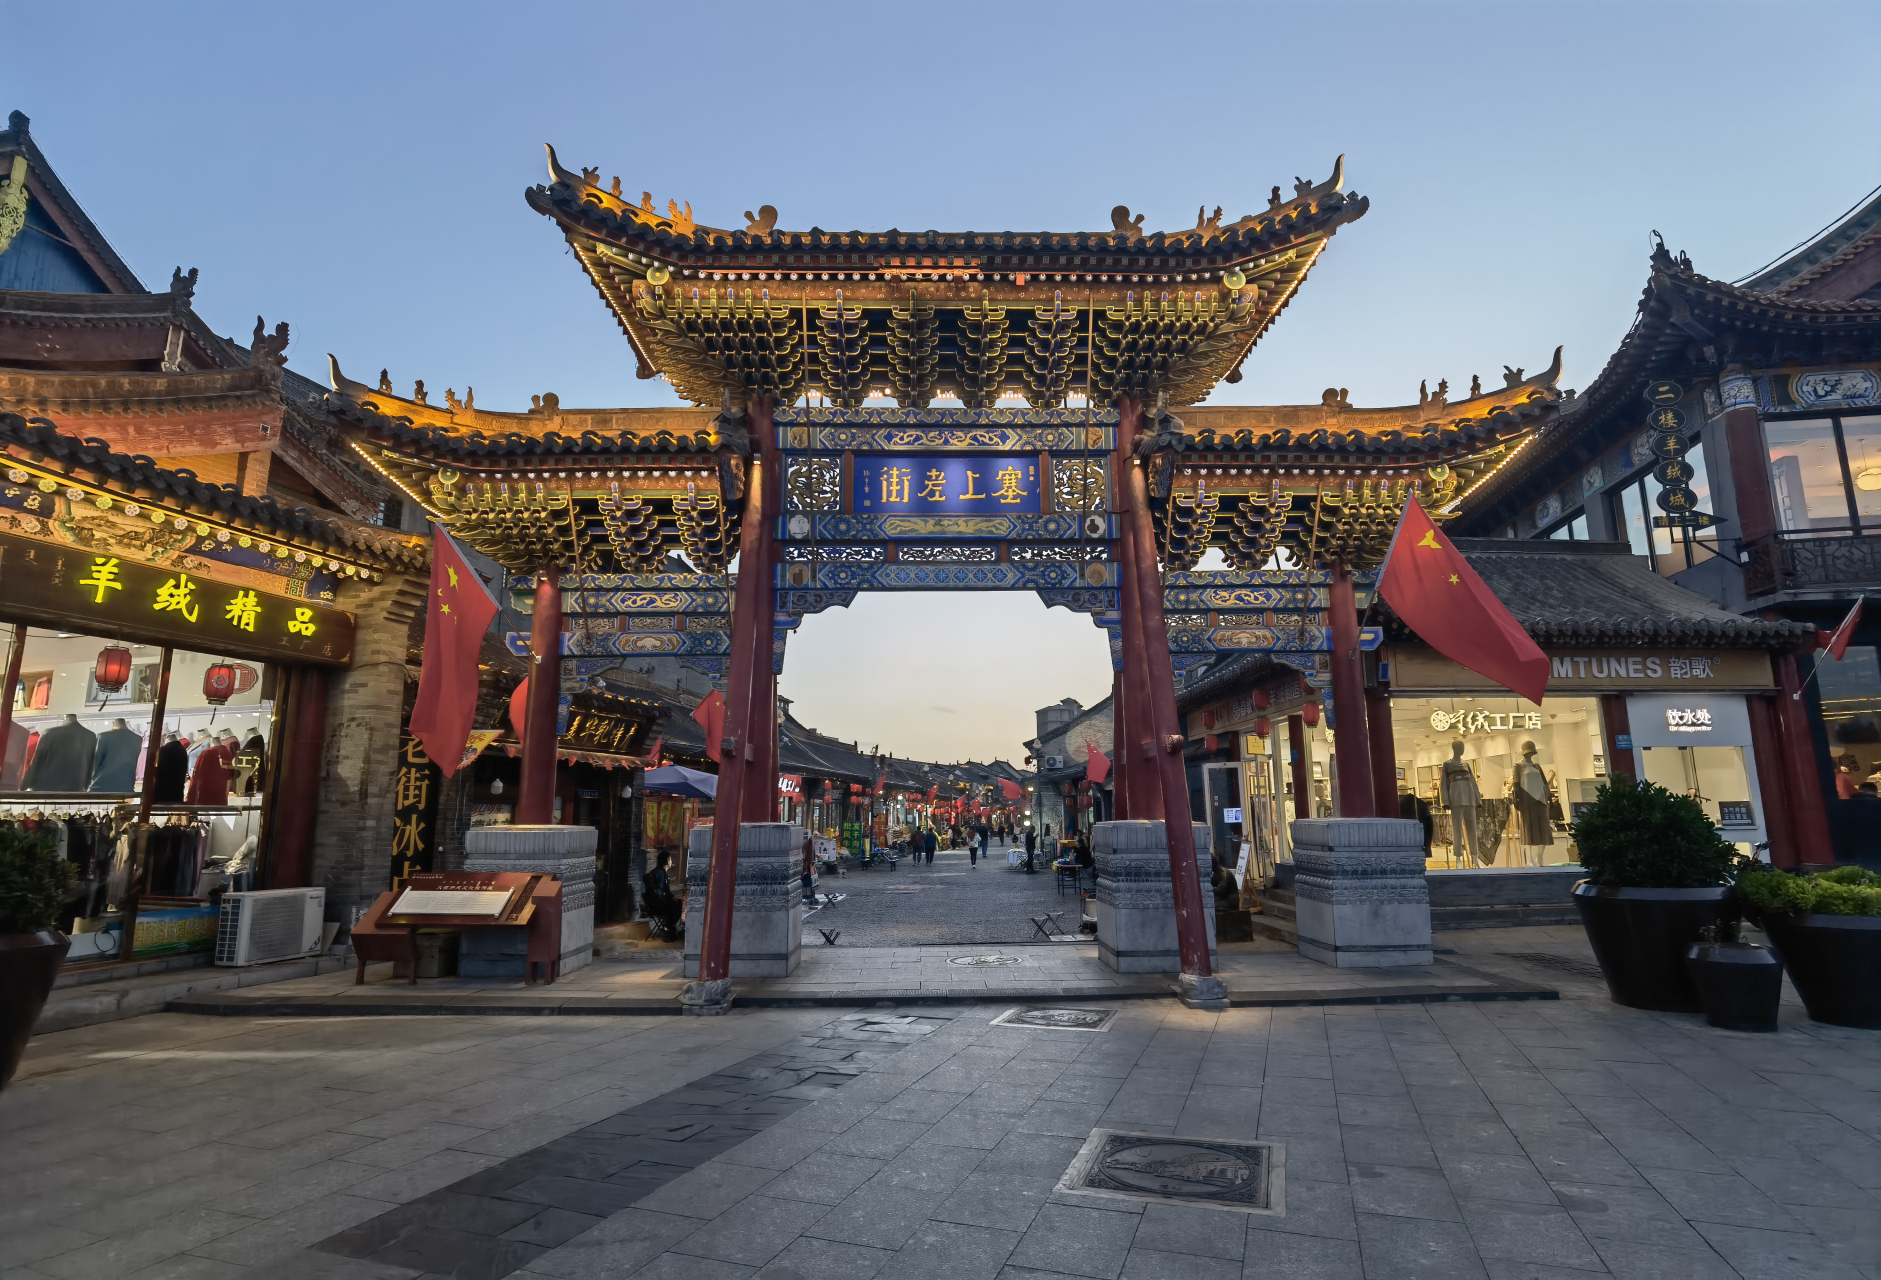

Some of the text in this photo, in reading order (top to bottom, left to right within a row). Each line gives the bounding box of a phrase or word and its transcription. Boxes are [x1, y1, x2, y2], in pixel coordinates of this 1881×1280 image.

[1655, 385, 1690, 509] 二楼羊绒城
[880, 465, 1028, 504] 塞上老街
[79, 557, 316, 637] 羊绒精品
[278, 636, 332, 657] 工厂店
[1549, 656, 1662, 679] MTUNES
[1668, 656, 1714, 679] 韵歌
[1450, 709, 1542, 735] 羊绒工厂店
[1665, 708, 1712, 725] 饮水处
[842, 831, 860, 839] 风干
[843, 822, 861, 831] 批发
[842, 840, 860, 848] 牛肉
